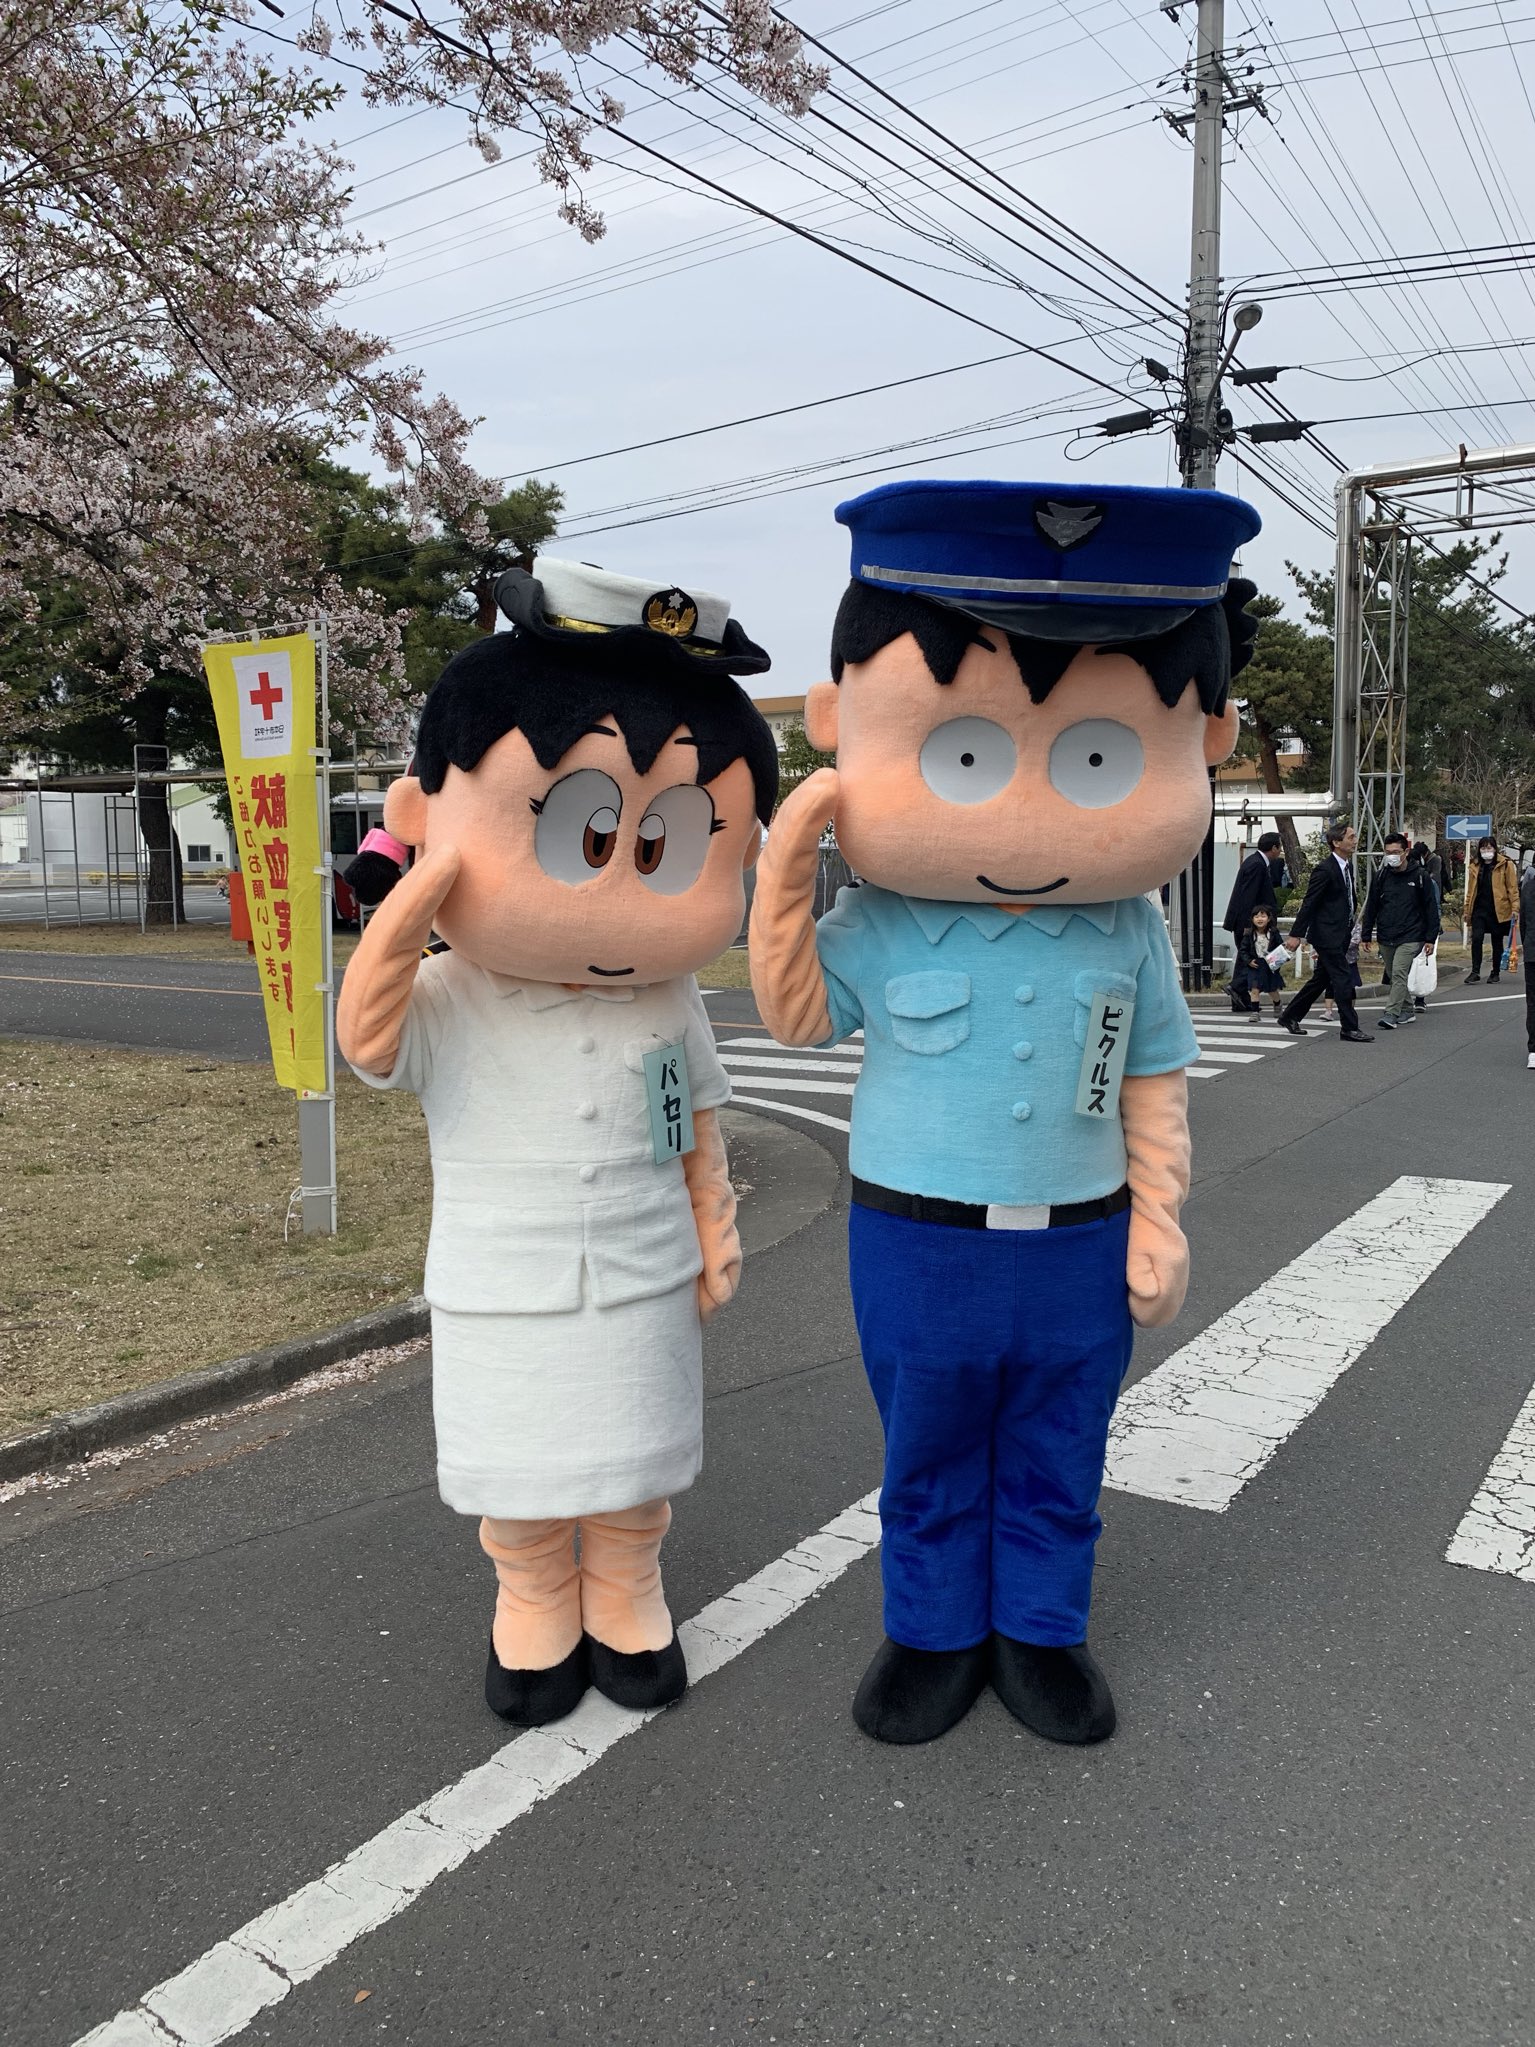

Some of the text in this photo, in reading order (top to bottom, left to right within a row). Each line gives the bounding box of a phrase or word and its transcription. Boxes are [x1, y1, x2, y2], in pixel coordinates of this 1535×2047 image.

[660, 1058, 682, 1153] パセリ
[1087, 1005, 1124, 1114] ピクルス
